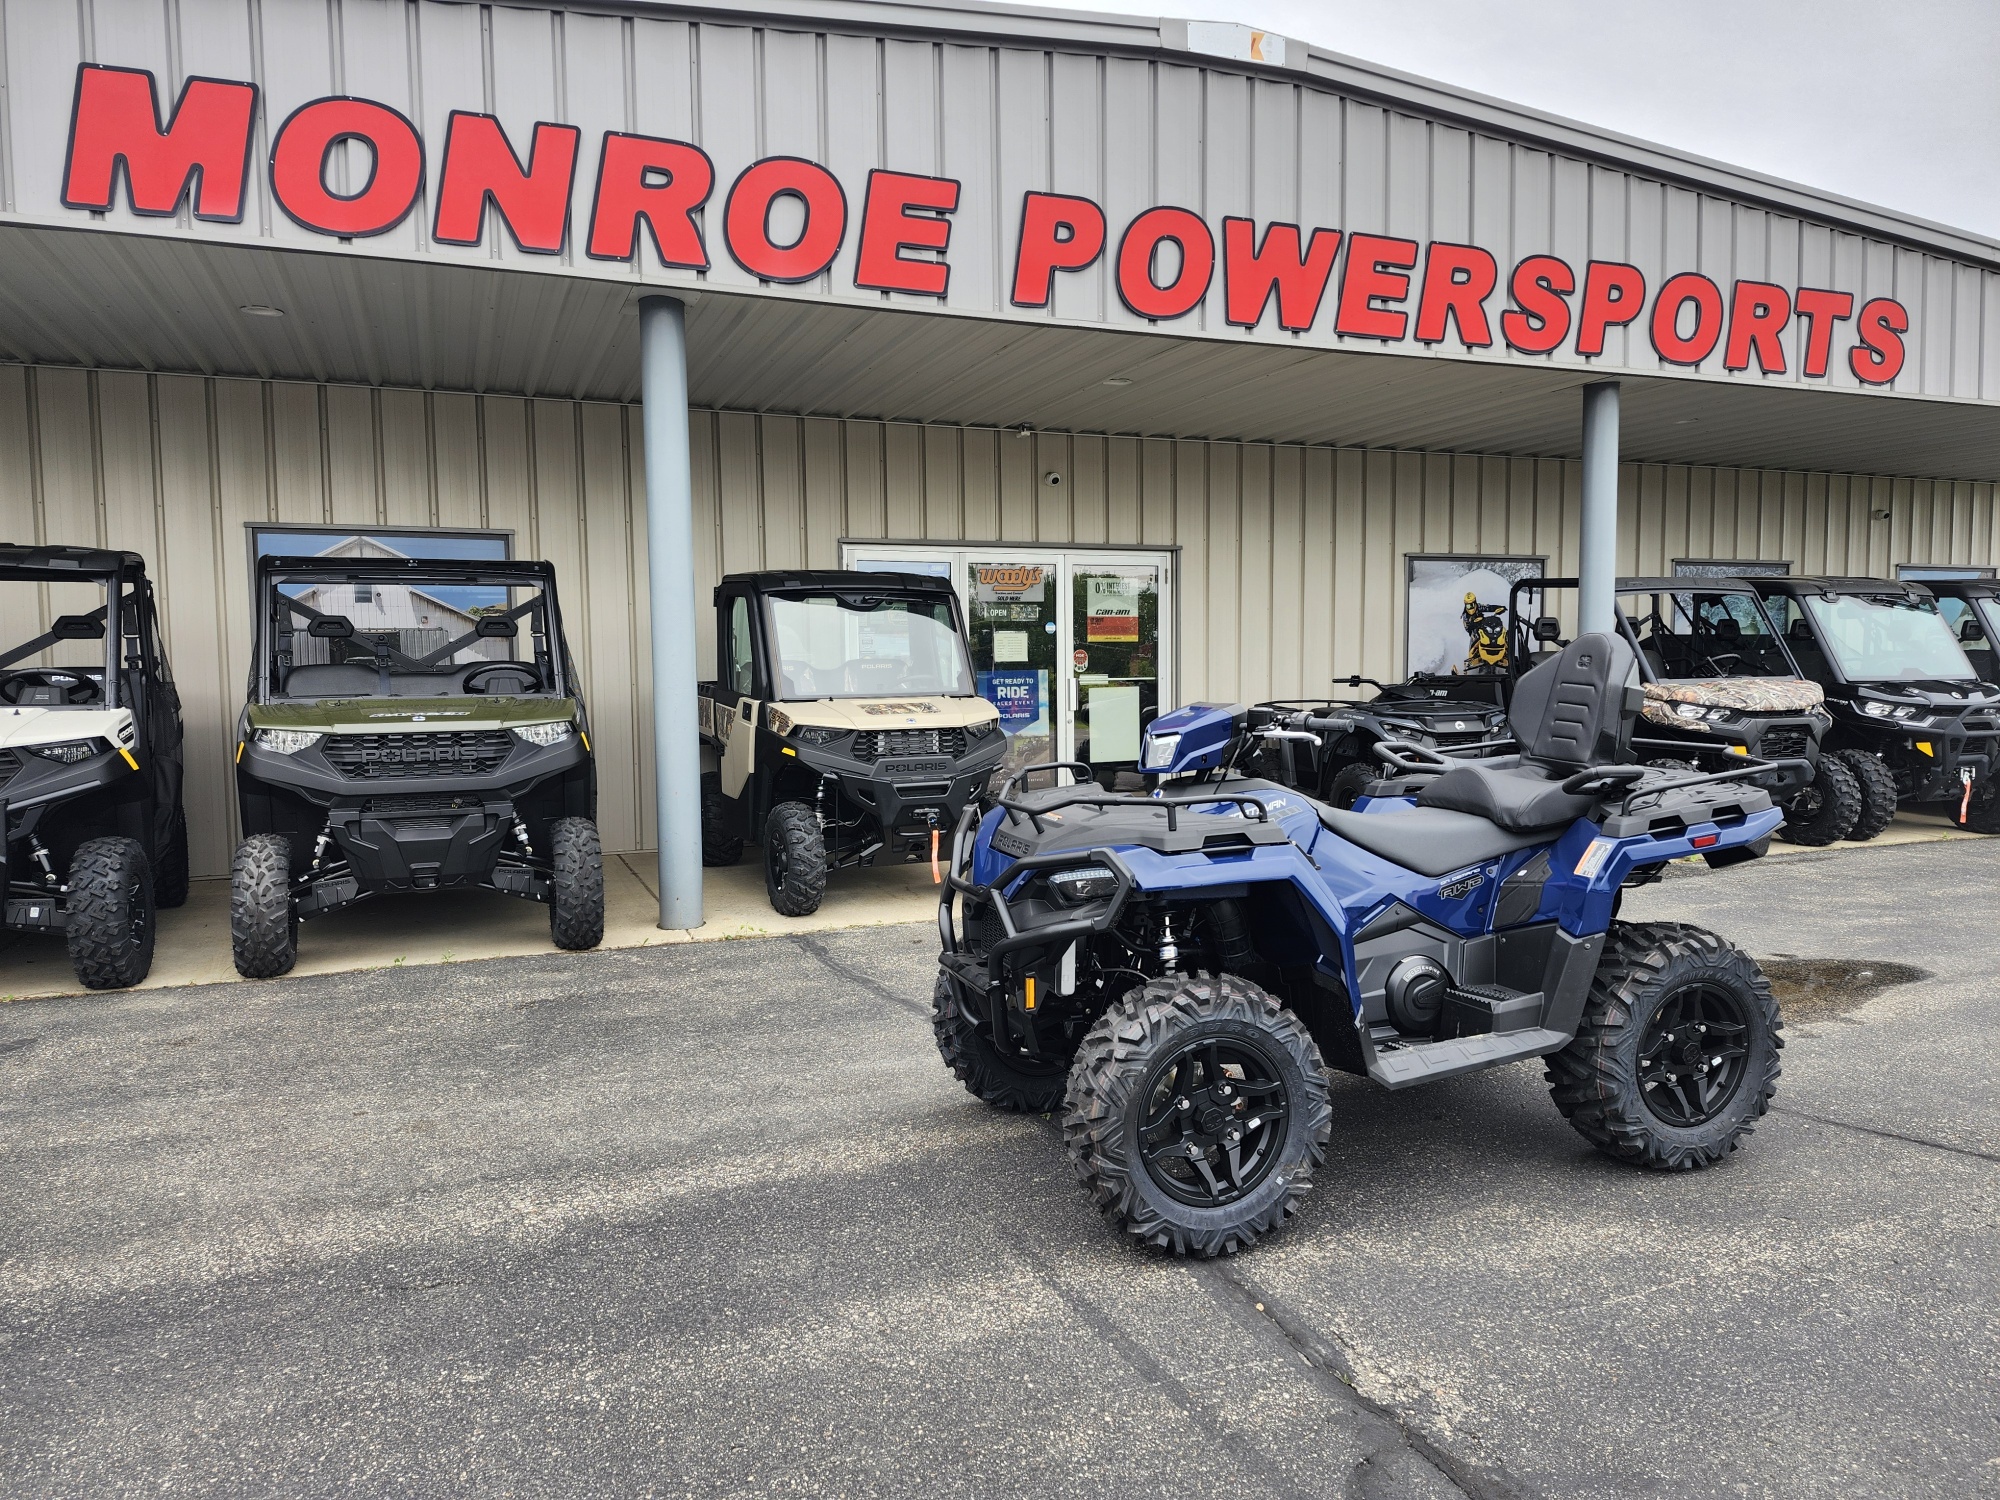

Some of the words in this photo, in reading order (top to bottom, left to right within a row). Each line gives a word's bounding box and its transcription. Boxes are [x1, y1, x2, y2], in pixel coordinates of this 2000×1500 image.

[61, 62, 962, 296] MONROE
[1010, 190, 1909, 385] POWERSPORTS
[998, 686, 1029, 700] RIDE
[361, 746, 478, 762] POLARIS
[885, 762, 947, 773] POLARIS
[996, 834, 1030, 855] POLARIS
[1441, 876, 1482, 900] AWD
